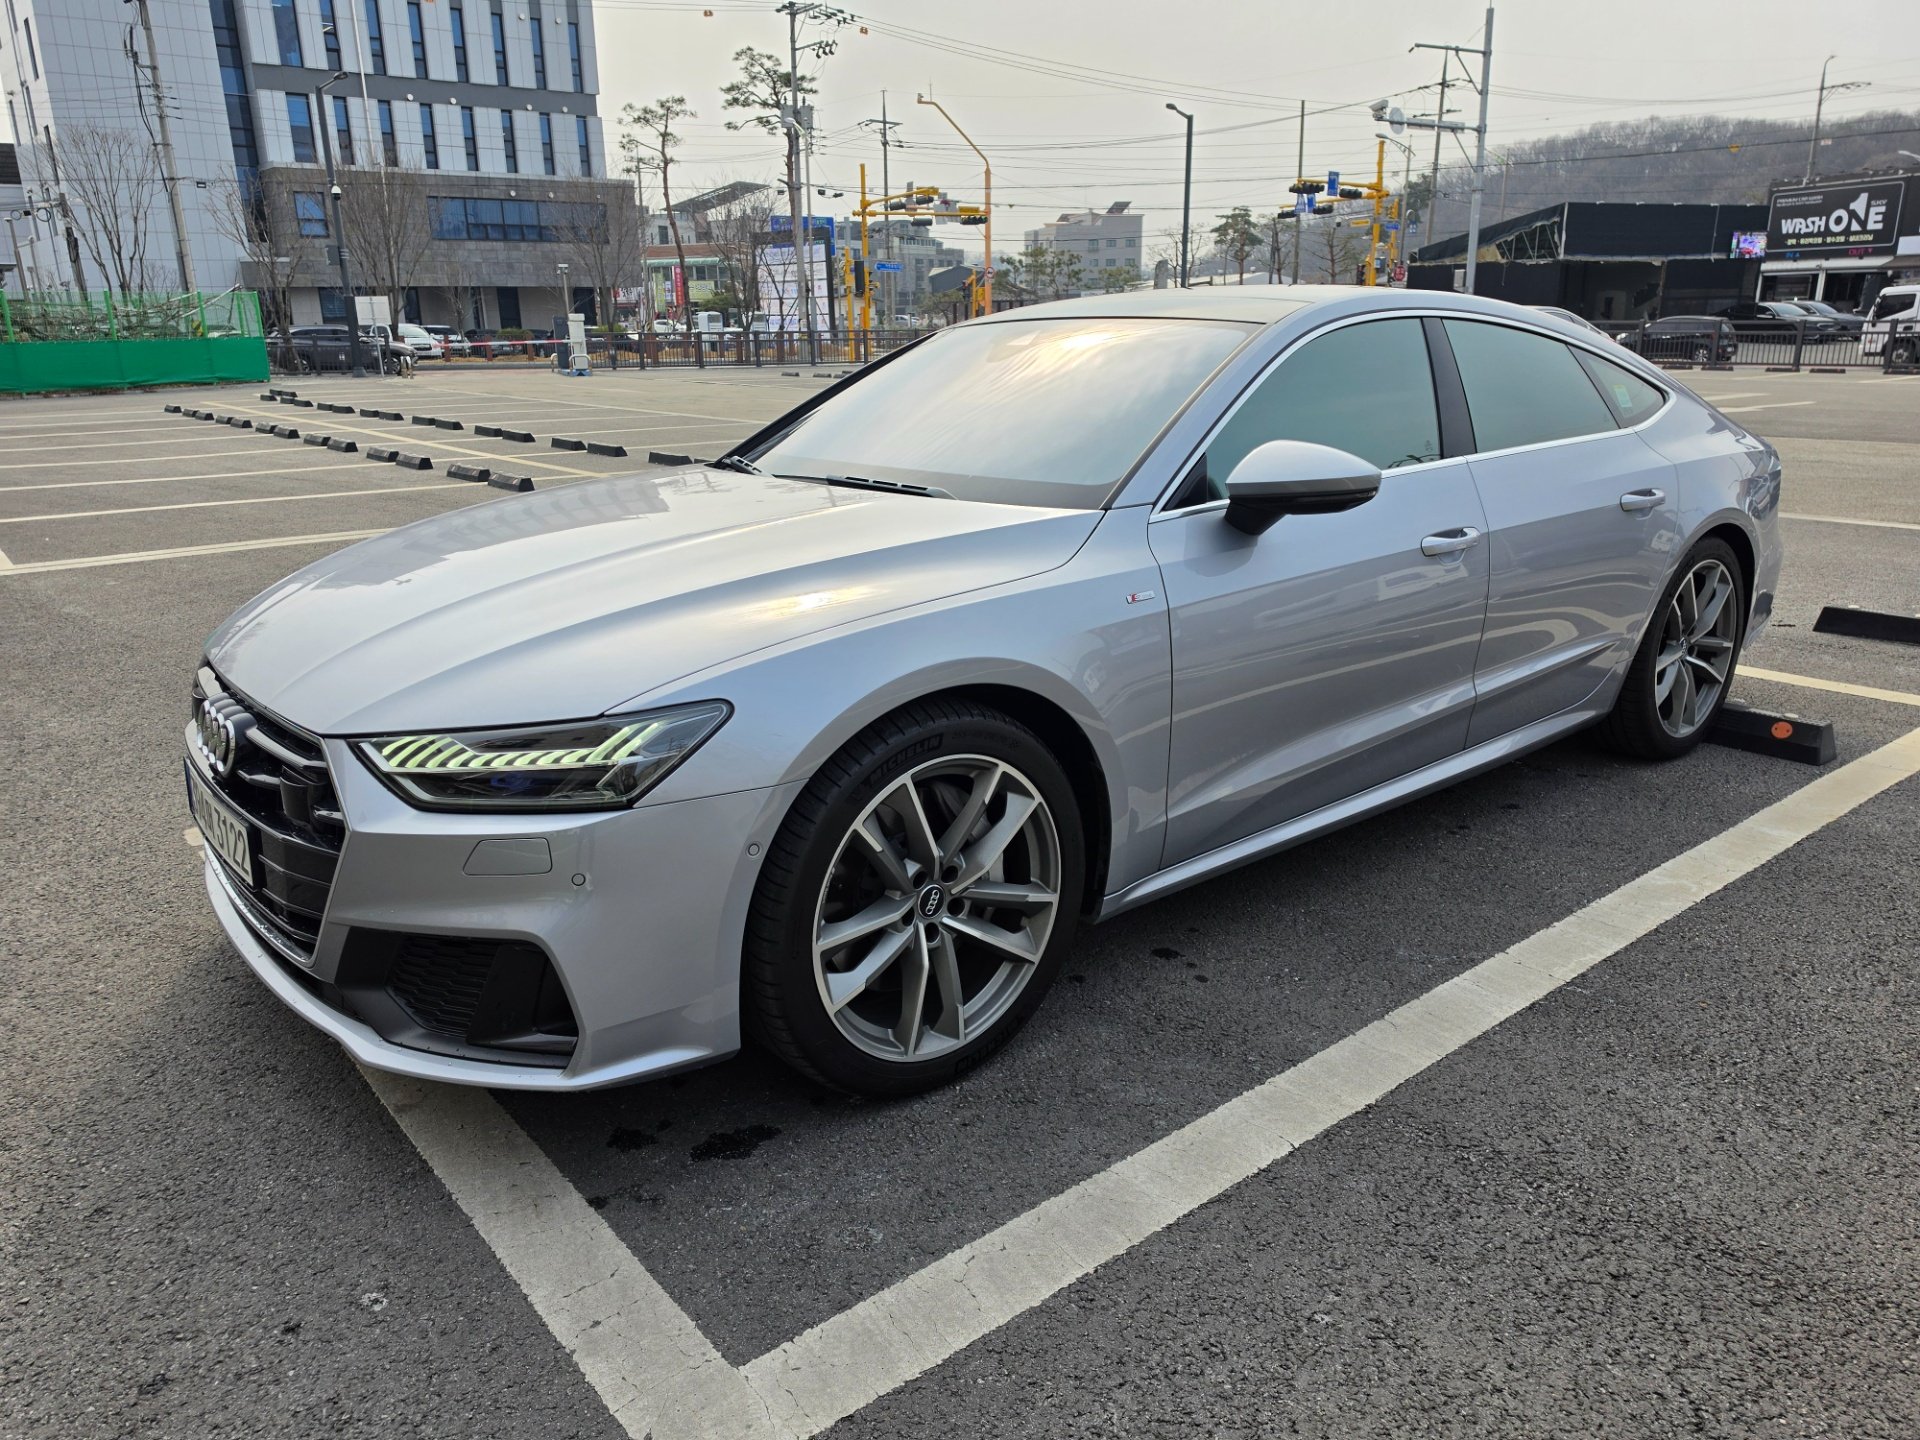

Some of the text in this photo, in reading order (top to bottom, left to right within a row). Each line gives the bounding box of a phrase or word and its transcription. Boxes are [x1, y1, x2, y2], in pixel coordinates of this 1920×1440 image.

[1781, 216, 1826, 235] WASH
[868, 732, 945, 788] MICHELIN
[213, 806, 249, 876] 3122
